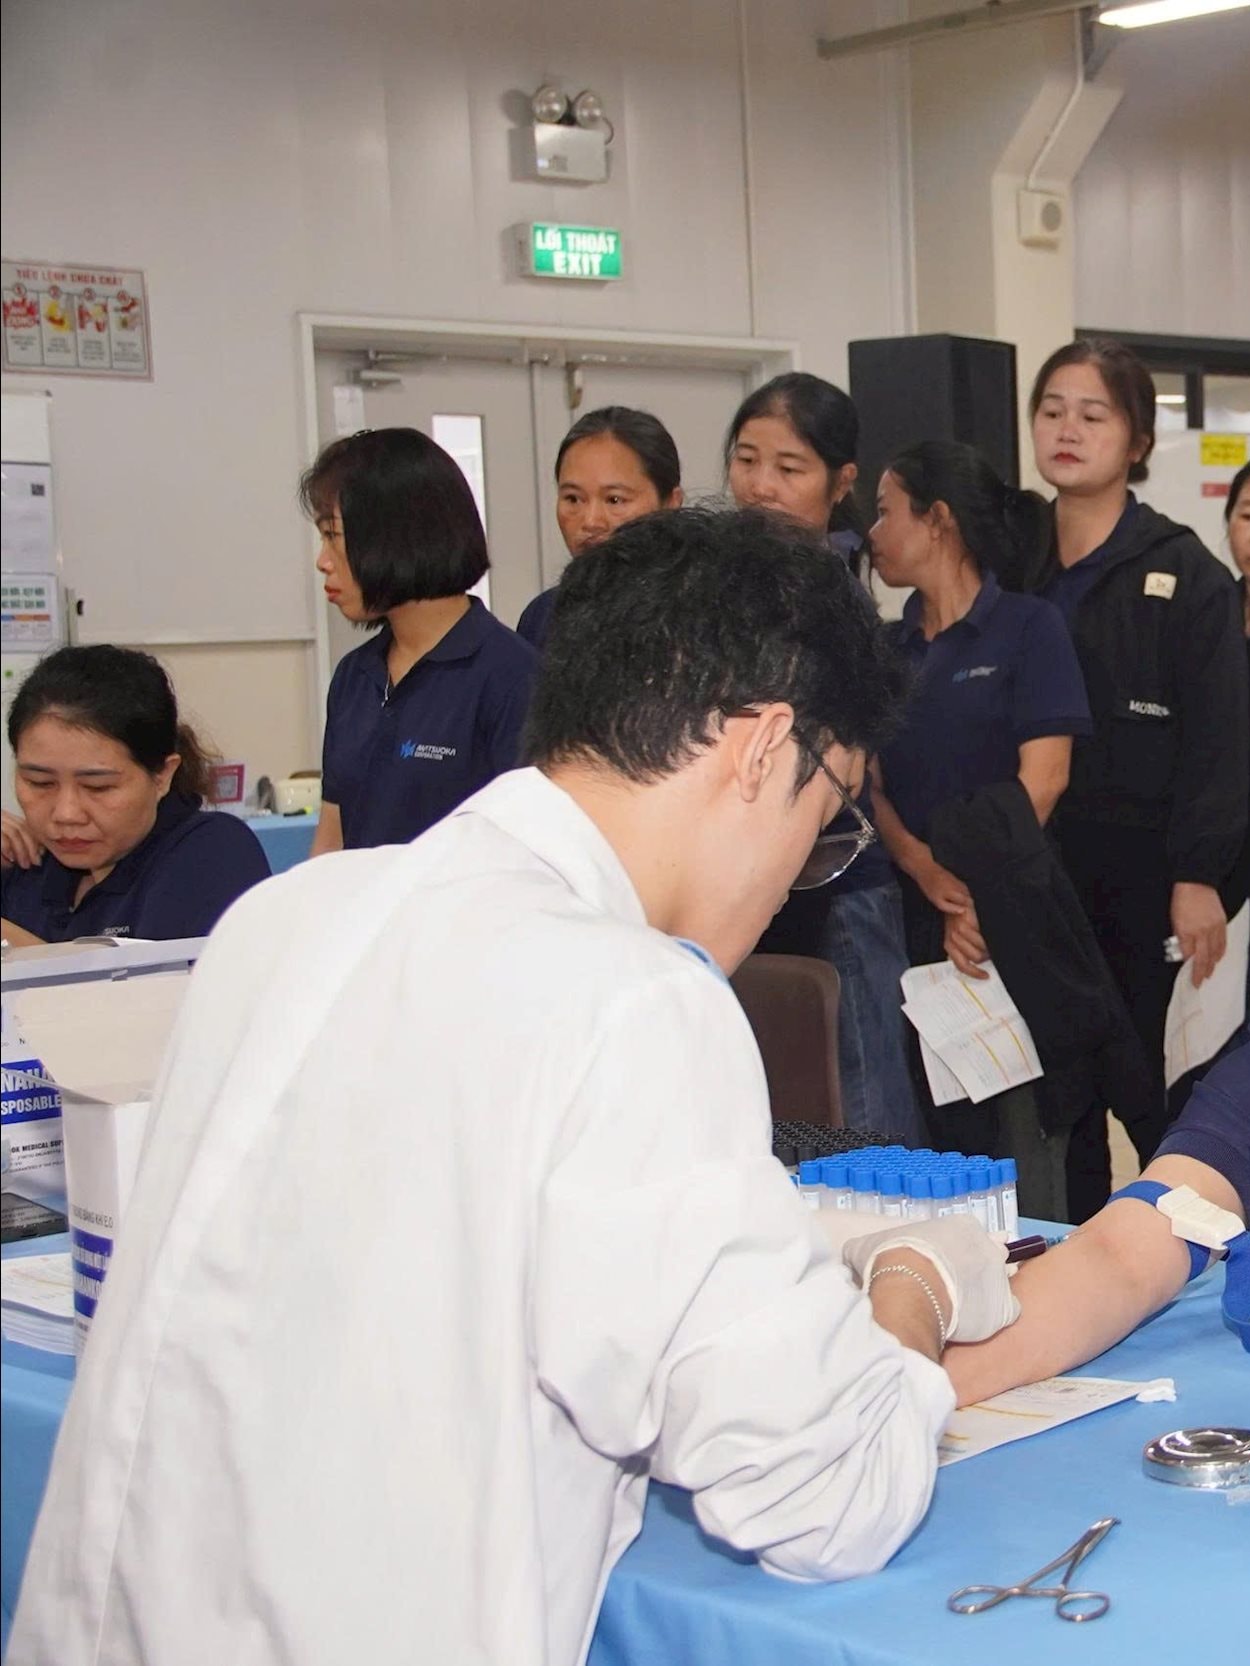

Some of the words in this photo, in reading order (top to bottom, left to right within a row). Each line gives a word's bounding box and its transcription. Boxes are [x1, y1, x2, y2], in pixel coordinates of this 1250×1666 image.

[553, 251, 602, 275] EXIT
[1, 1093, 61, 1116] SPOSABLE
[22, 1140, 49, 1152] MEDICAL
